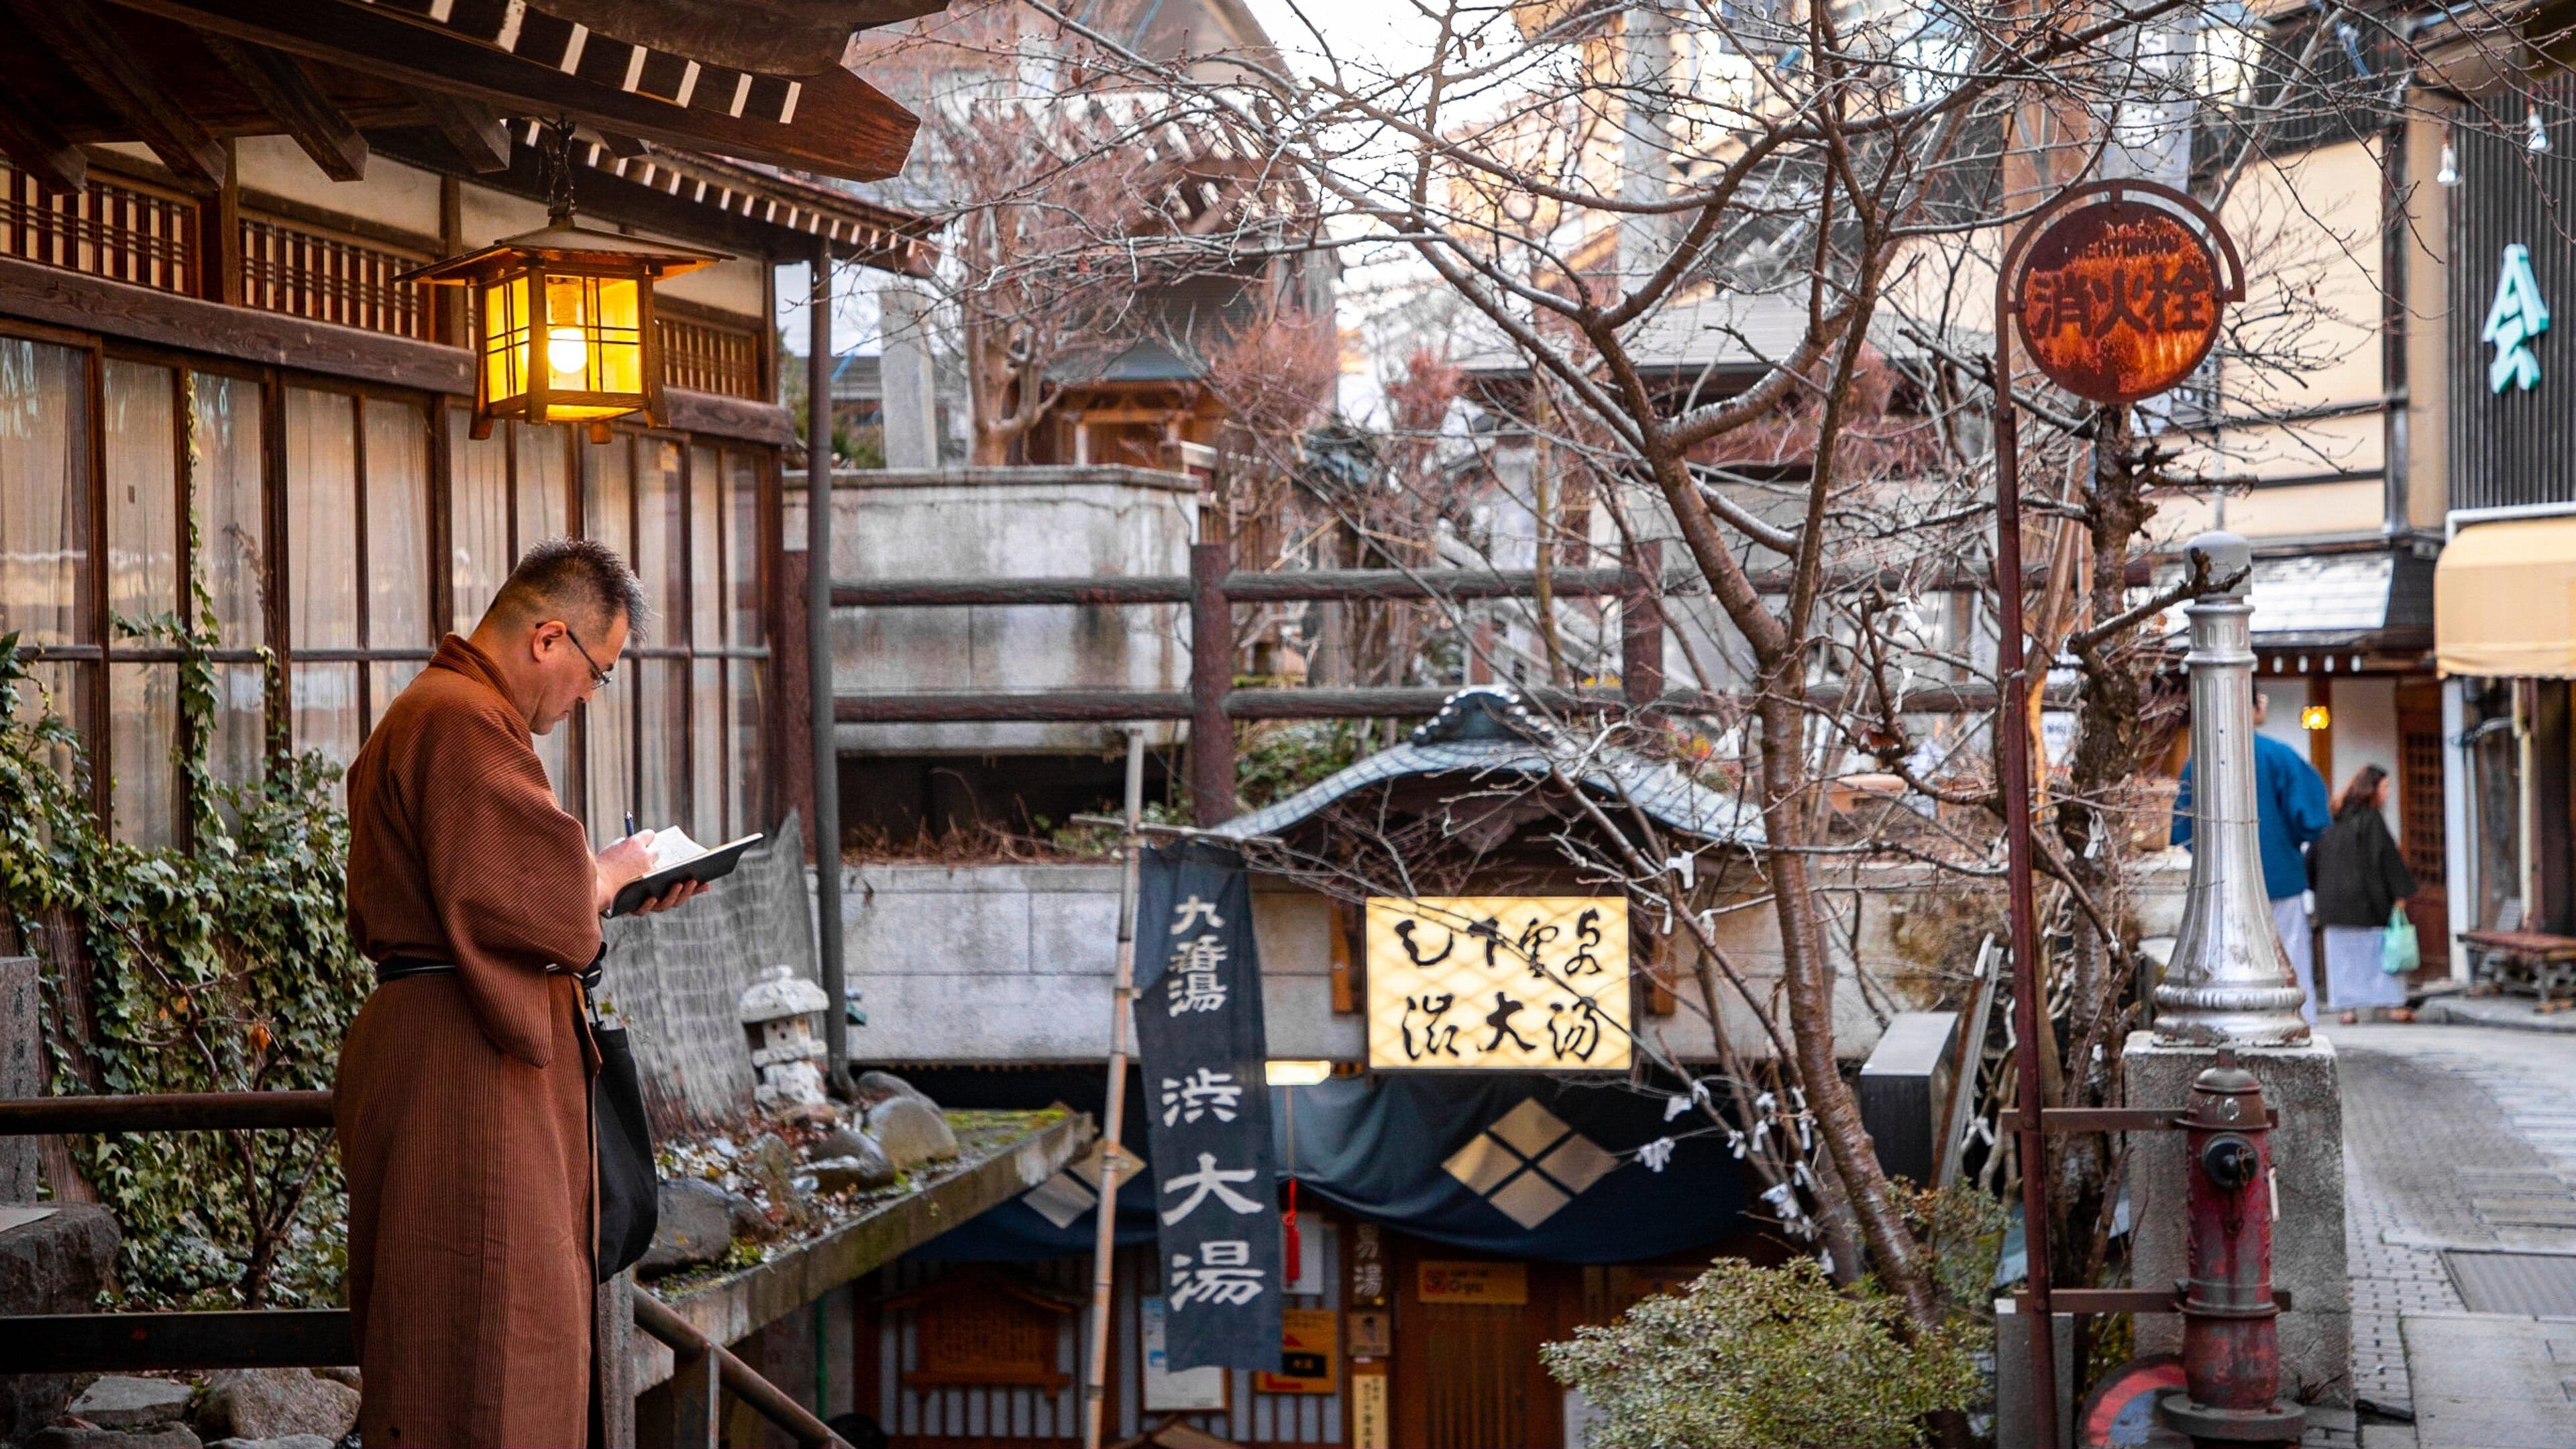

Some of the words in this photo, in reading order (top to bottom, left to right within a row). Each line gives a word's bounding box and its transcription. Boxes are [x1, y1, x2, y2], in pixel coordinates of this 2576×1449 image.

[2029, 264, 2209, 338] 消火栓
[1161, 1067, 1266, 1312] 渋大湯
